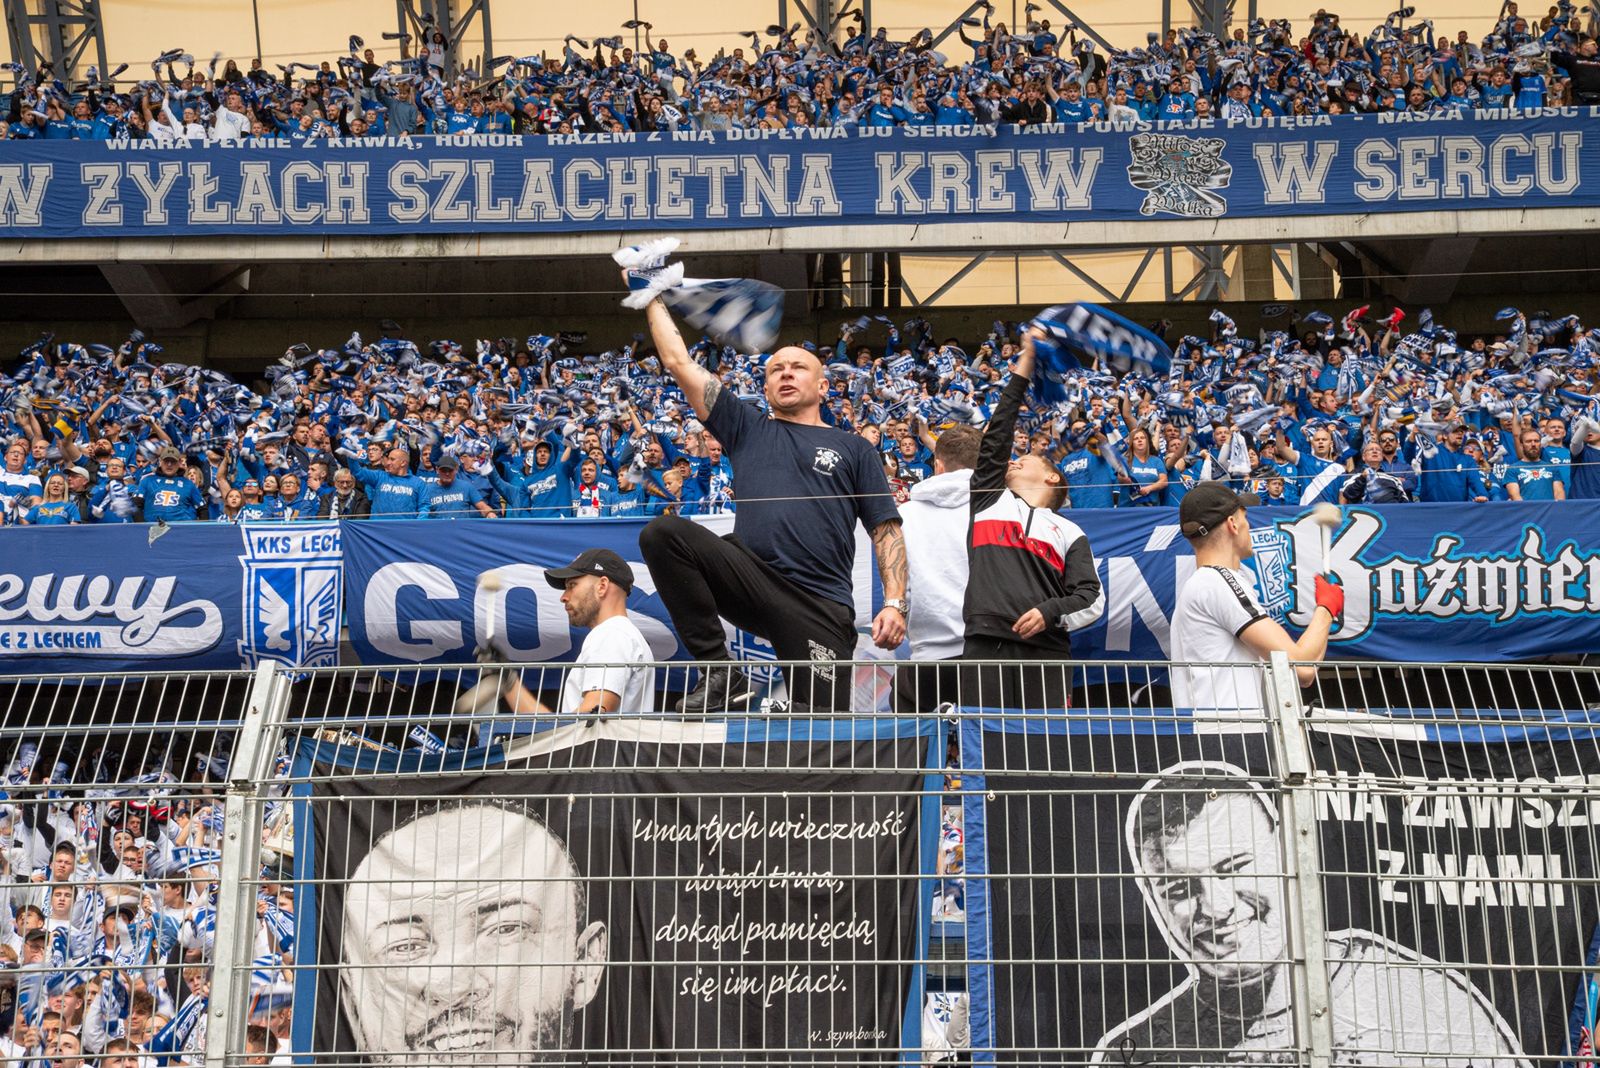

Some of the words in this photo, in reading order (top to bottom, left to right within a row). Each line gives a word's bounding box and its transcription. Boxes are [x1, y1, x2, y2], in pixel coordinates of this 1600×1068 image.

[105, 138, 192, 150] WIARA
[302, 137, 317, 148] Z
[436, 135, 523, 147] HONOR
[548, 131, 636, 145] RAZEM
[672, 130, 716, 144] NIĄ
[726, 126, 849, 141] DOPŁYWA
[1077, 119, 1214, 134] POWSTAJE
[1377, 110, 1464, 124] NASZA
[388, 153, 842, 225] SZLACHETNA
[875, 146, 1103, 215] KREW
[1253, 140, 1339, 205] W
[1354, 130, 1584, 202] SERCU
[153, 490, 180, 507] STS
[257, 536, 291, 553] KKS
[301, 534, 343, 553] LECH
[1252, 534, 1278, 544] LECH
[17, 631, 28, 648] Z
[34, 631, 101, 649] LECHEM
[1314, 770, 1388, 824] NA
[634, 811, 764, 856] Umarłych
[768, 810, 907, 841] wieczność
[1377, 850, 1408, 904] Z
[1422, 852, 1565, 907] NAMI
[655, 912, 742, 950] dokąd
[741, 912, 876, 955] pamięcią
[680, 967, 720, 1002] się
[724, 967, 763, 995] im
[763, 965, 848, 1008] płaci.
